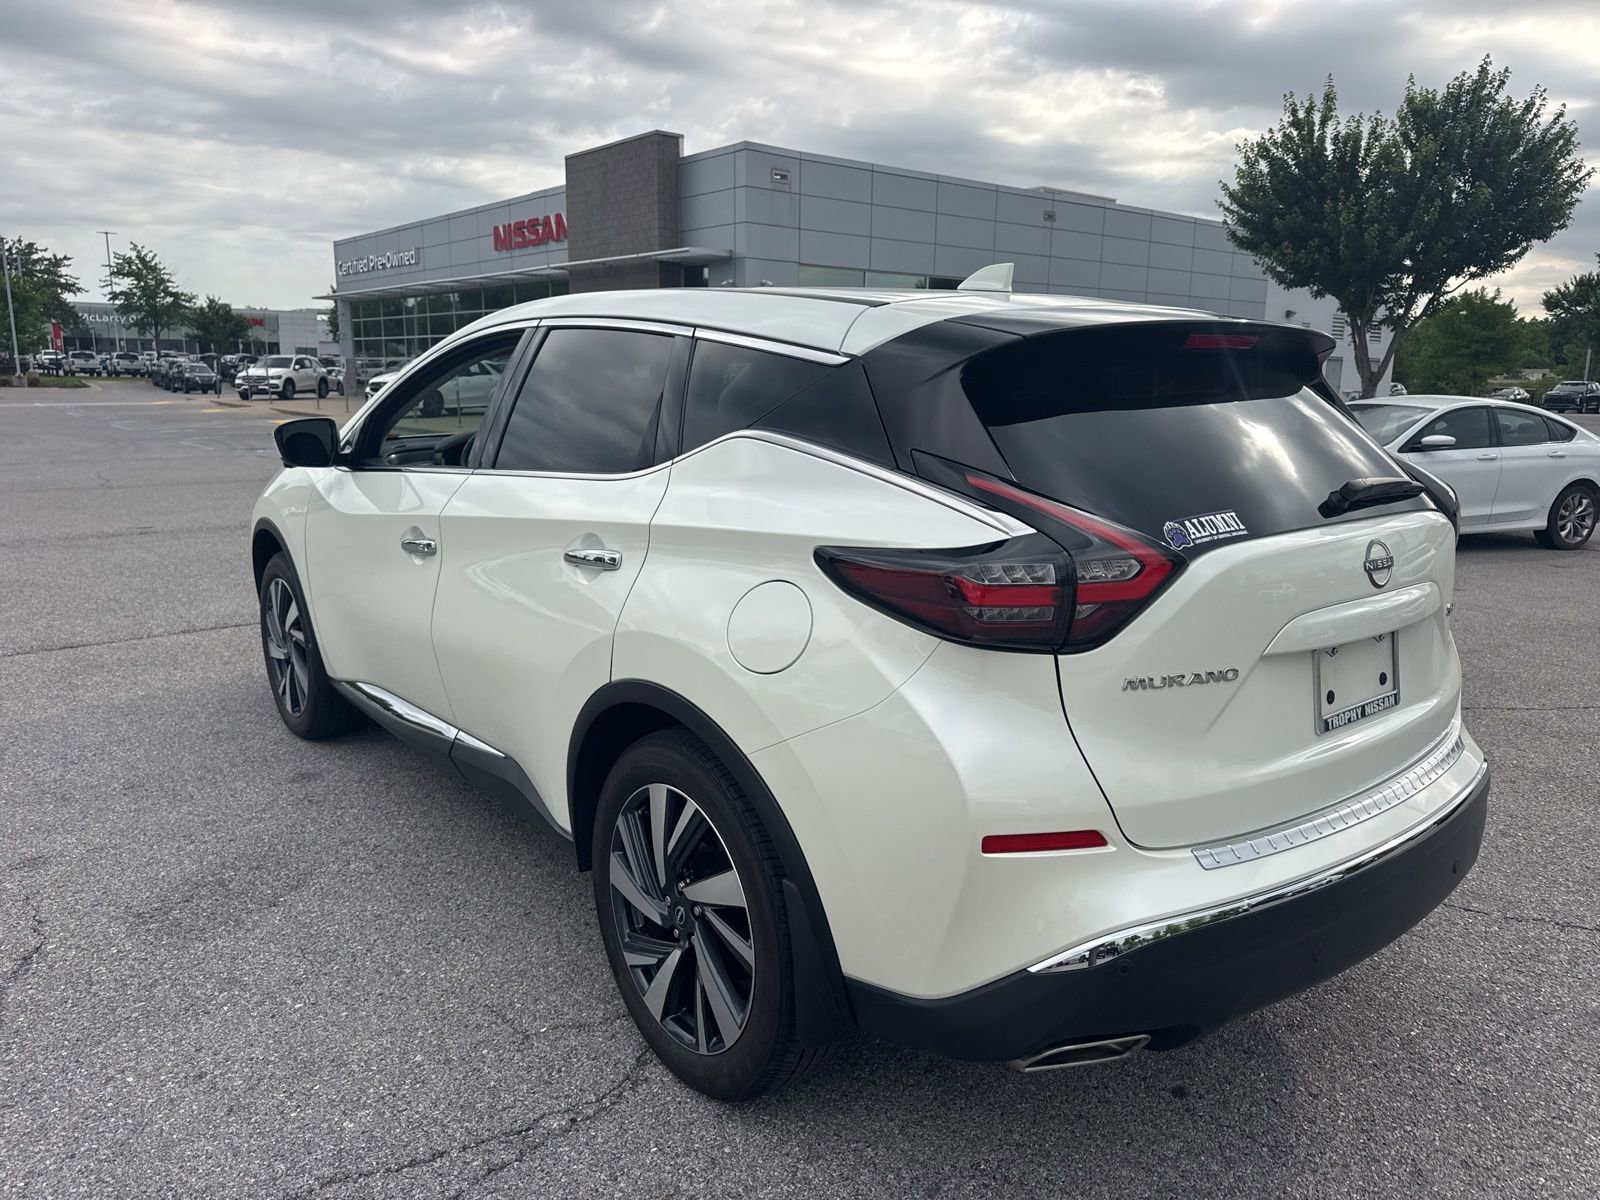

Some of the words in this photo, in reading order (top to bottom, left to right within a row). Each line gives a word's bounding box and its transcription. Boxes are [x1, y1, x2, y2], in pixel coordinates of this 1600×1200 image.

[493, 212, 568, 252] NISSAN
[337, 256, 368, 276] Certified
[369, 248, 416, 271] Pre-Owned
[1184, 512, 1246, 539] ALUMNI
[1121, 667, 1239, 692] MURANO
[1326, 706, 1363, 730] TROPHY
[1364, 694, 1396, 716] NISSAN
